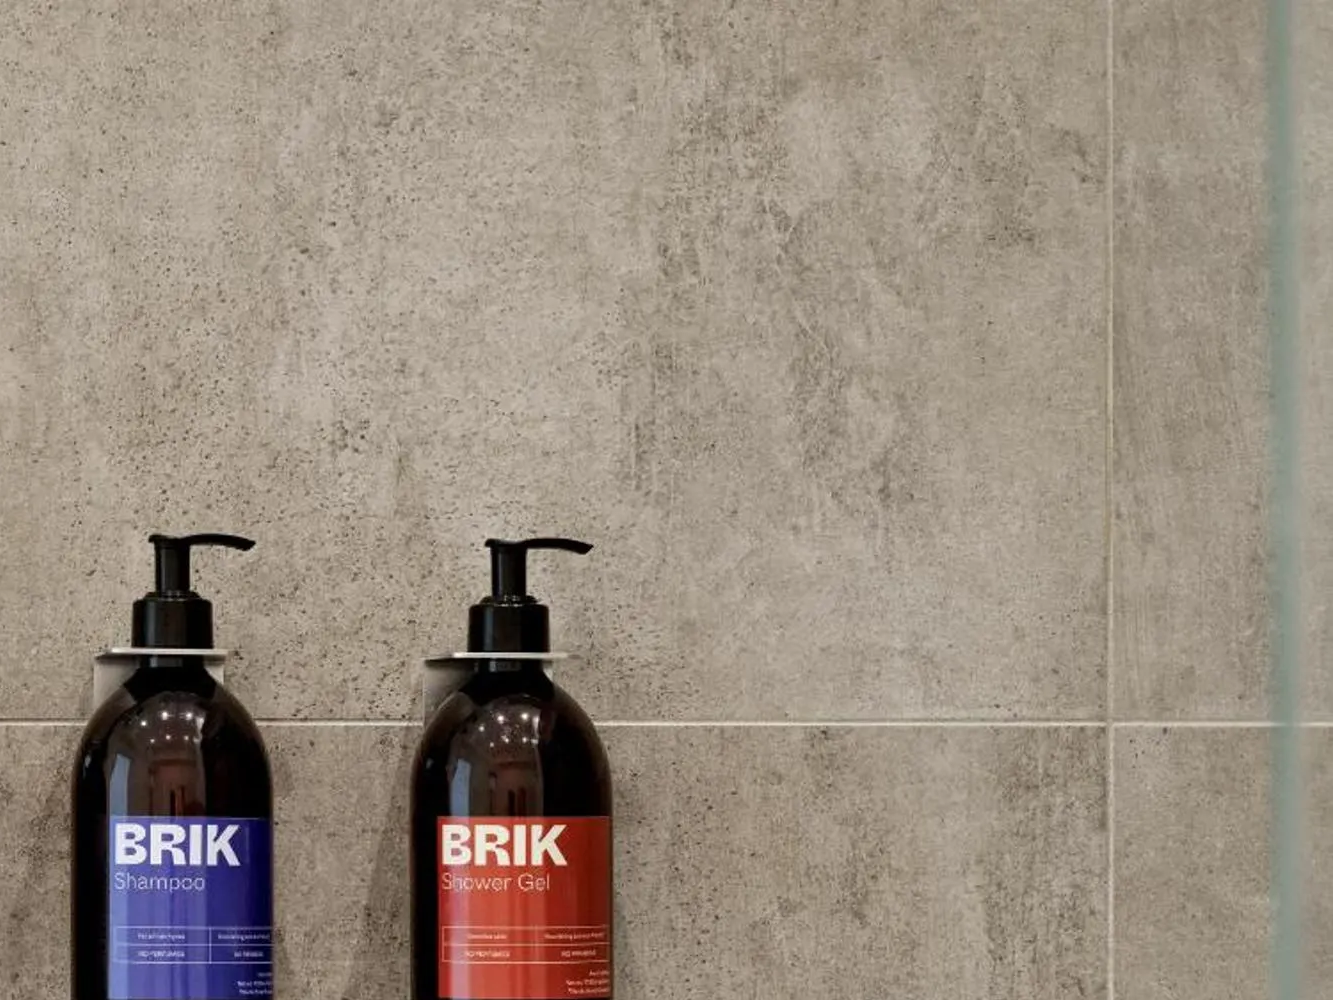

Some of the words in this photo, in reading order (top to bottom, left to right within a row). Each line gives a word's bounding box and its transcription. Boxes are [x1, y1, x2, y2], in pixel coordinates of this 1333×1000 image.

[115, 823, 241, 866] BRIK
[441, 824, 568, 866] BRIK
[114, 872, 206, 892] Shampoo
[442, 873, 512, 890] Shower
[517, 873, 550, 890] Gel
